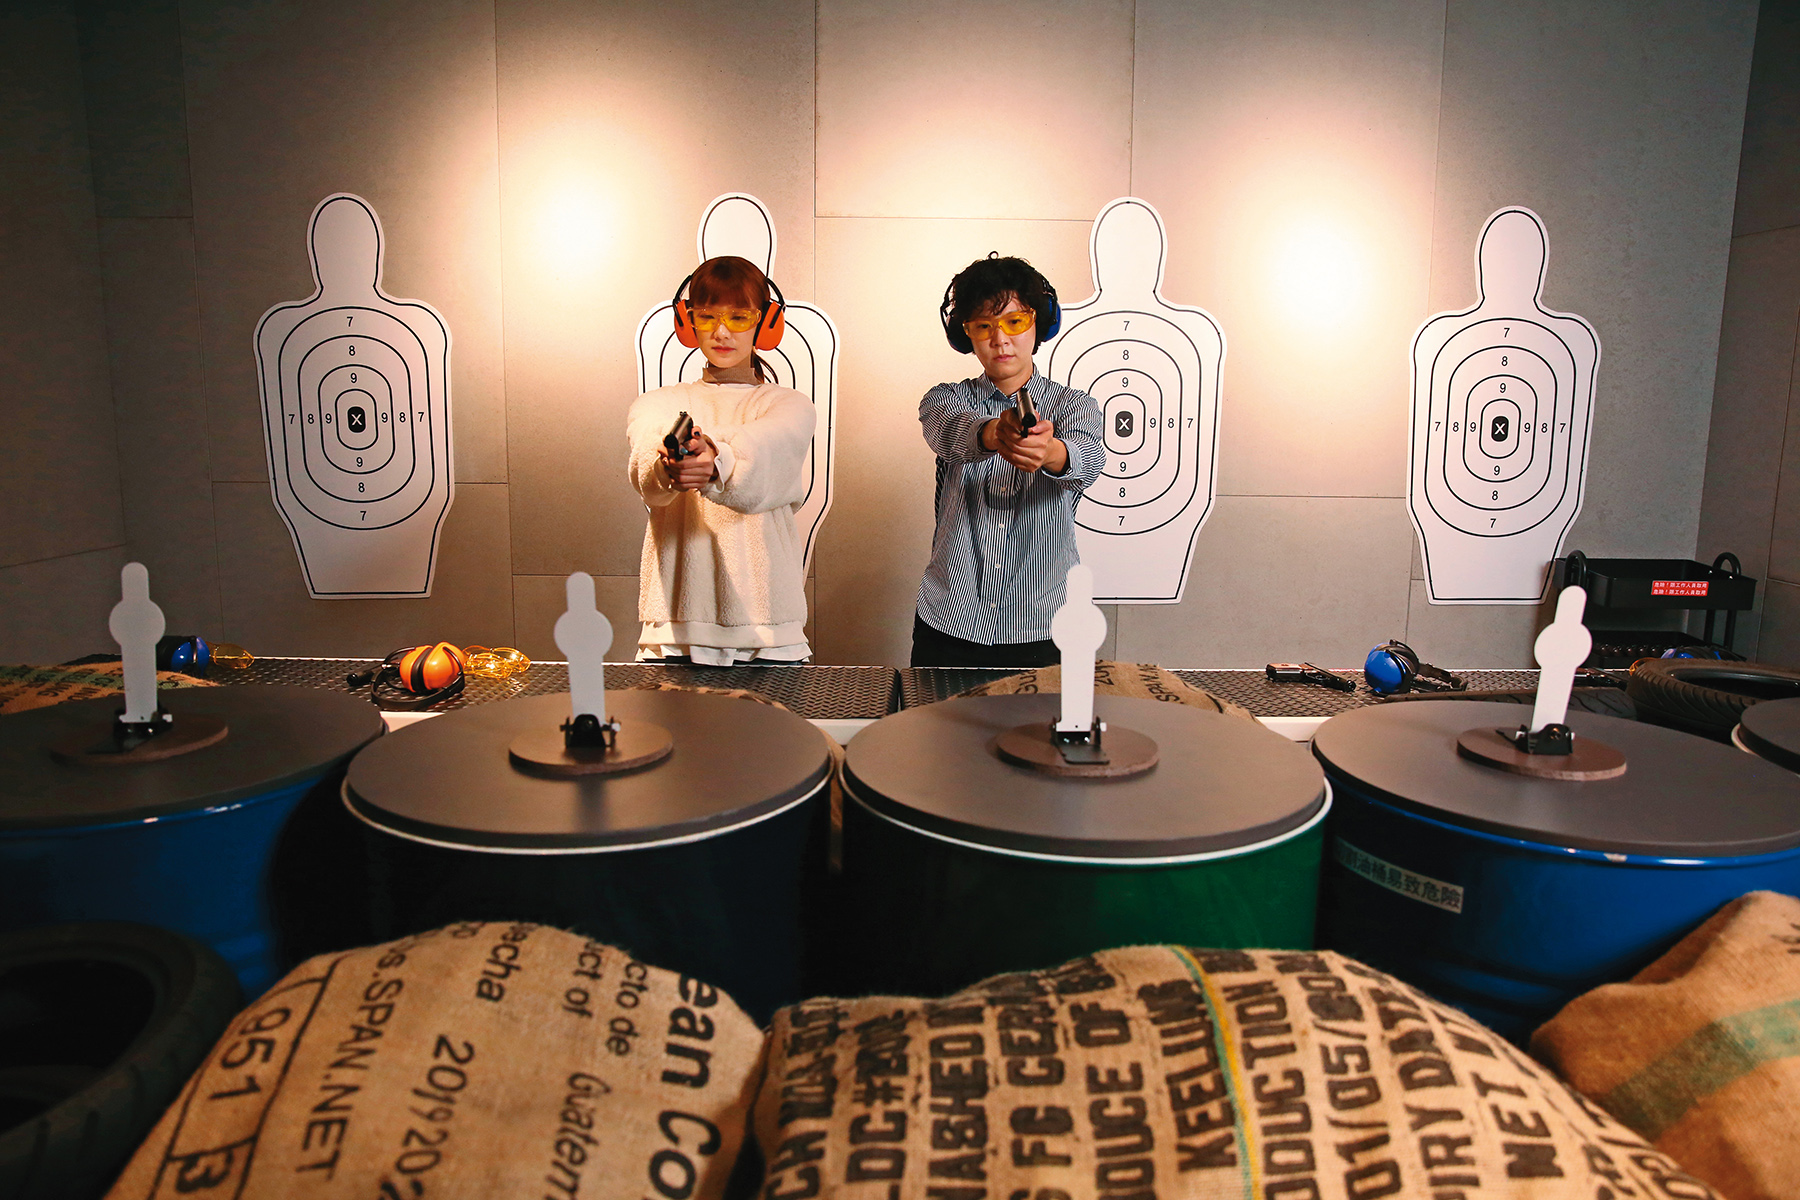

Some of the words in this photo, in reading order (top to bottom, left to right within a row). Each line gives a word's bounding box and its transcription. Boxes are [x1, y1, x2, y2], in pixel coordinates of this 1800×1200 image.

[346, 316, 353, 327] 7
[1123, 320, 1130, 331] 7
[1503, 327, 1510, 338] 7
[348, 345, 356, 356] 8
[1122, 349, 1130, 361] 8
[1501, 355, 1508, 367] 8
[350, 372, 357, 384] 9
[1121, 377, 1129, 388] 9
[1499, 382, 1507, 394] 9
[288, 413, 295, 424] 7
[307, 413, 315, 424] 8
[325, 413, 332, 424] 9
[351, 413, 363, 426] X
[381, 412, 388, 423] 9
[399, 412, 406, 423] 8
[417, 411, 425, 422] 7
[1118, 418, 1130, 431] X
[1149, 417, 1157, 429] 9
[1167, 417, 1175, 429] 8
[1187, 417, 1194, 428] 7
[1434, 421, 1441, 432] 7
[1452, 421, 1459, 433] 8
[1469, 421, 1477, 433] 9
[1494, 423, 1506, 435] X
[1523, 422, 1531, 433] 9
[1540, 422, 1548, 433] 8
[1559, 422, 1566, 433] 7
[356, 456, 363, 468] 9
[1119, 461, 1127, 473] 9
[1493, 465, 1501, 476] 9
[358, 482, 365, 493] 8
[1118, 487, 1126, 498] 8
[1491, 490, 1499, 501] 8
[360, 510, 367, 521] 7
[1118, 515, 1125, 526] 7
[1490, 518, 1497, 528] 7
[562, 987, 594, 1018] of
[605, 1016, 640, 1057] de
[206, 1007, 292, 1101] 951
[1468, 1070, 1566, 1179] NET
